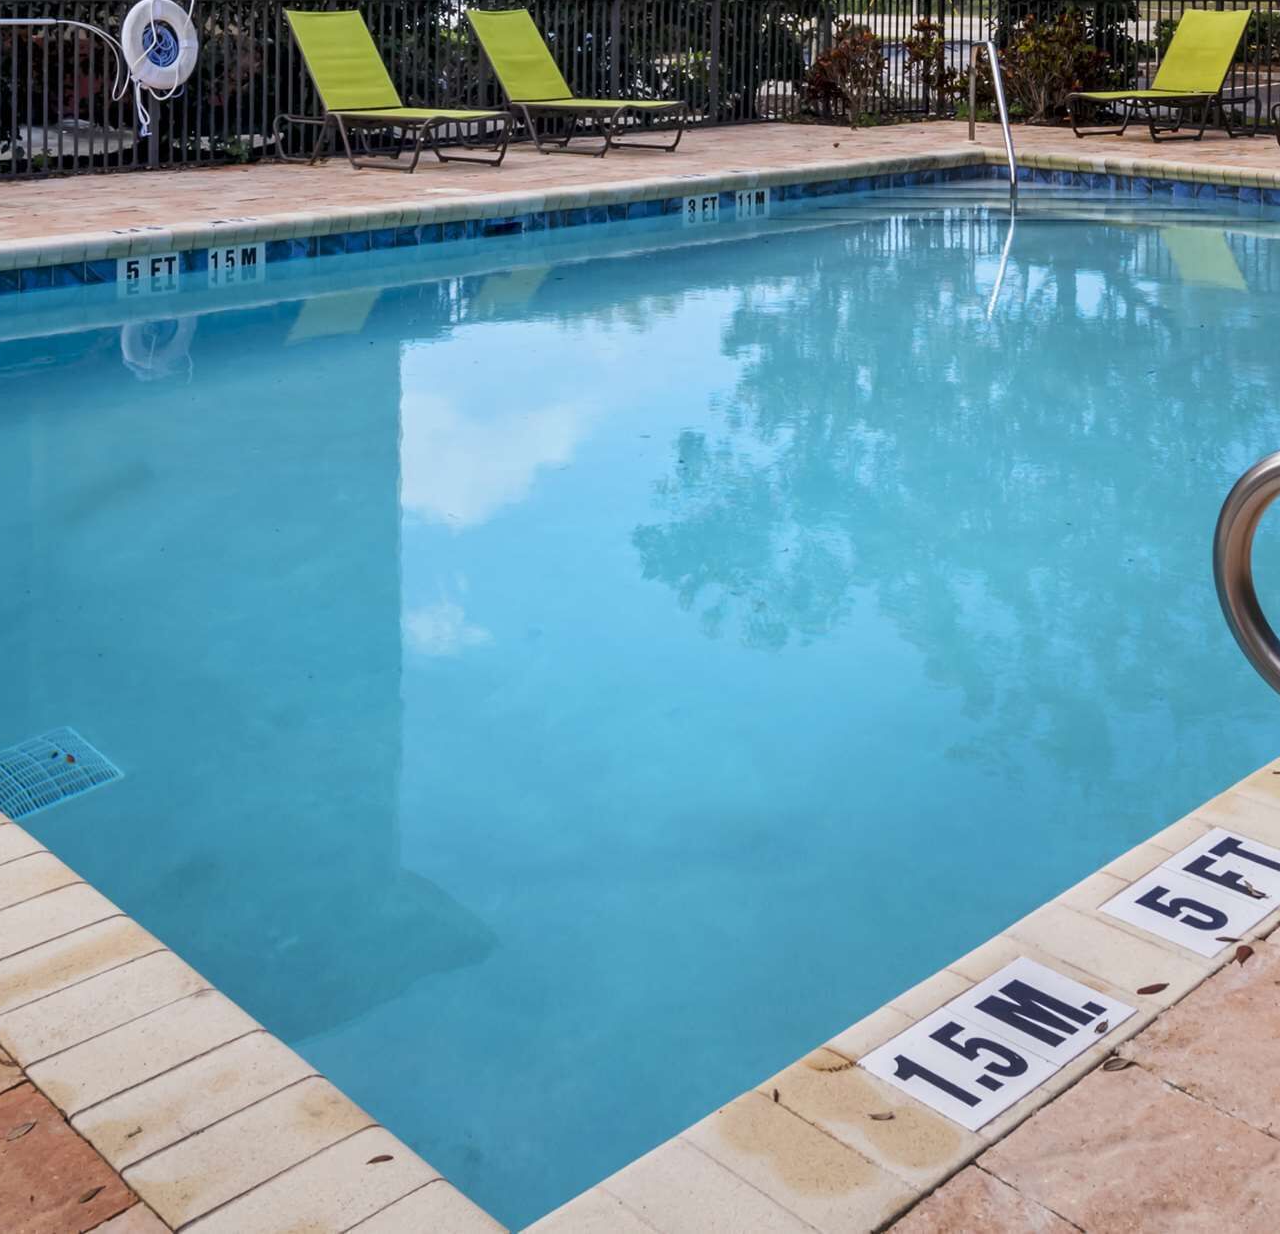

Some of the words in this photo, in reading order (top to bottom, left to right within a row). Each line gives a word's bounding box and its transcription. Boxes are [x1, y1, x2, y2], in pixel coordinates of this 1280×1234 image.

[702, 197, 718, 212] FT
[127, 260, 139, 279] 5
[151, 256, 177, 276] FT
[1134, 885, 1228, 931] 5
